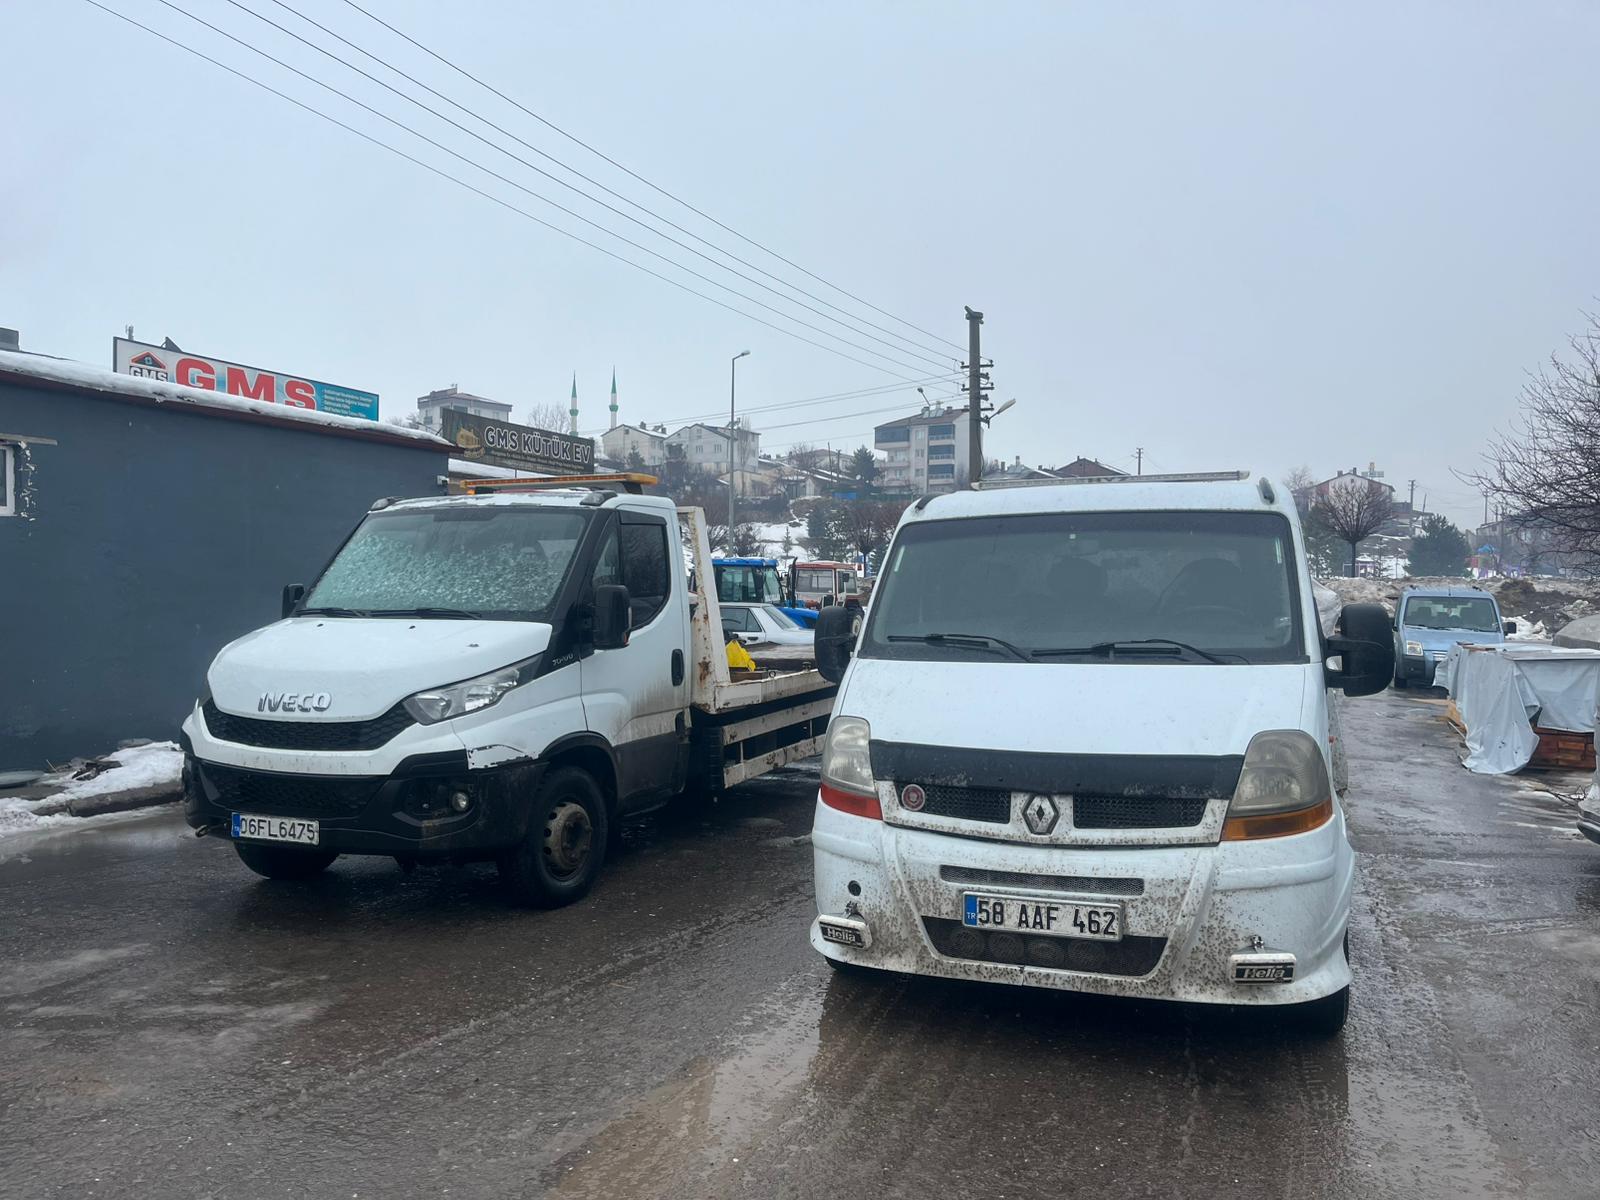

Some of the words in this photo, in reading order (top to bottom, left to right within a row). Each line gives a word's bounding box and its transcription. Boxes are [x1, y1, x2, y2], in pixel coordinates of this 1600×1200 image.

[130, 366, 168, 382] GMS
[175, 357, 317, 411] GMS
[484, 425, 518, 451] GMS
[523, 431, 571, 461] KÜTÜK
[573, 443, 591, 464] EV
[257, 691, 332, 713] IVECO
[966, 911, 977, 920] TR
[978, 900, 1004, 926] 58
[1018, 903, 1059, 930] AAF
[1073, 908, 1117, 936] 462
[827, 927, 856, 942] Hella
[1243, 967, 1286, 978] Hella
